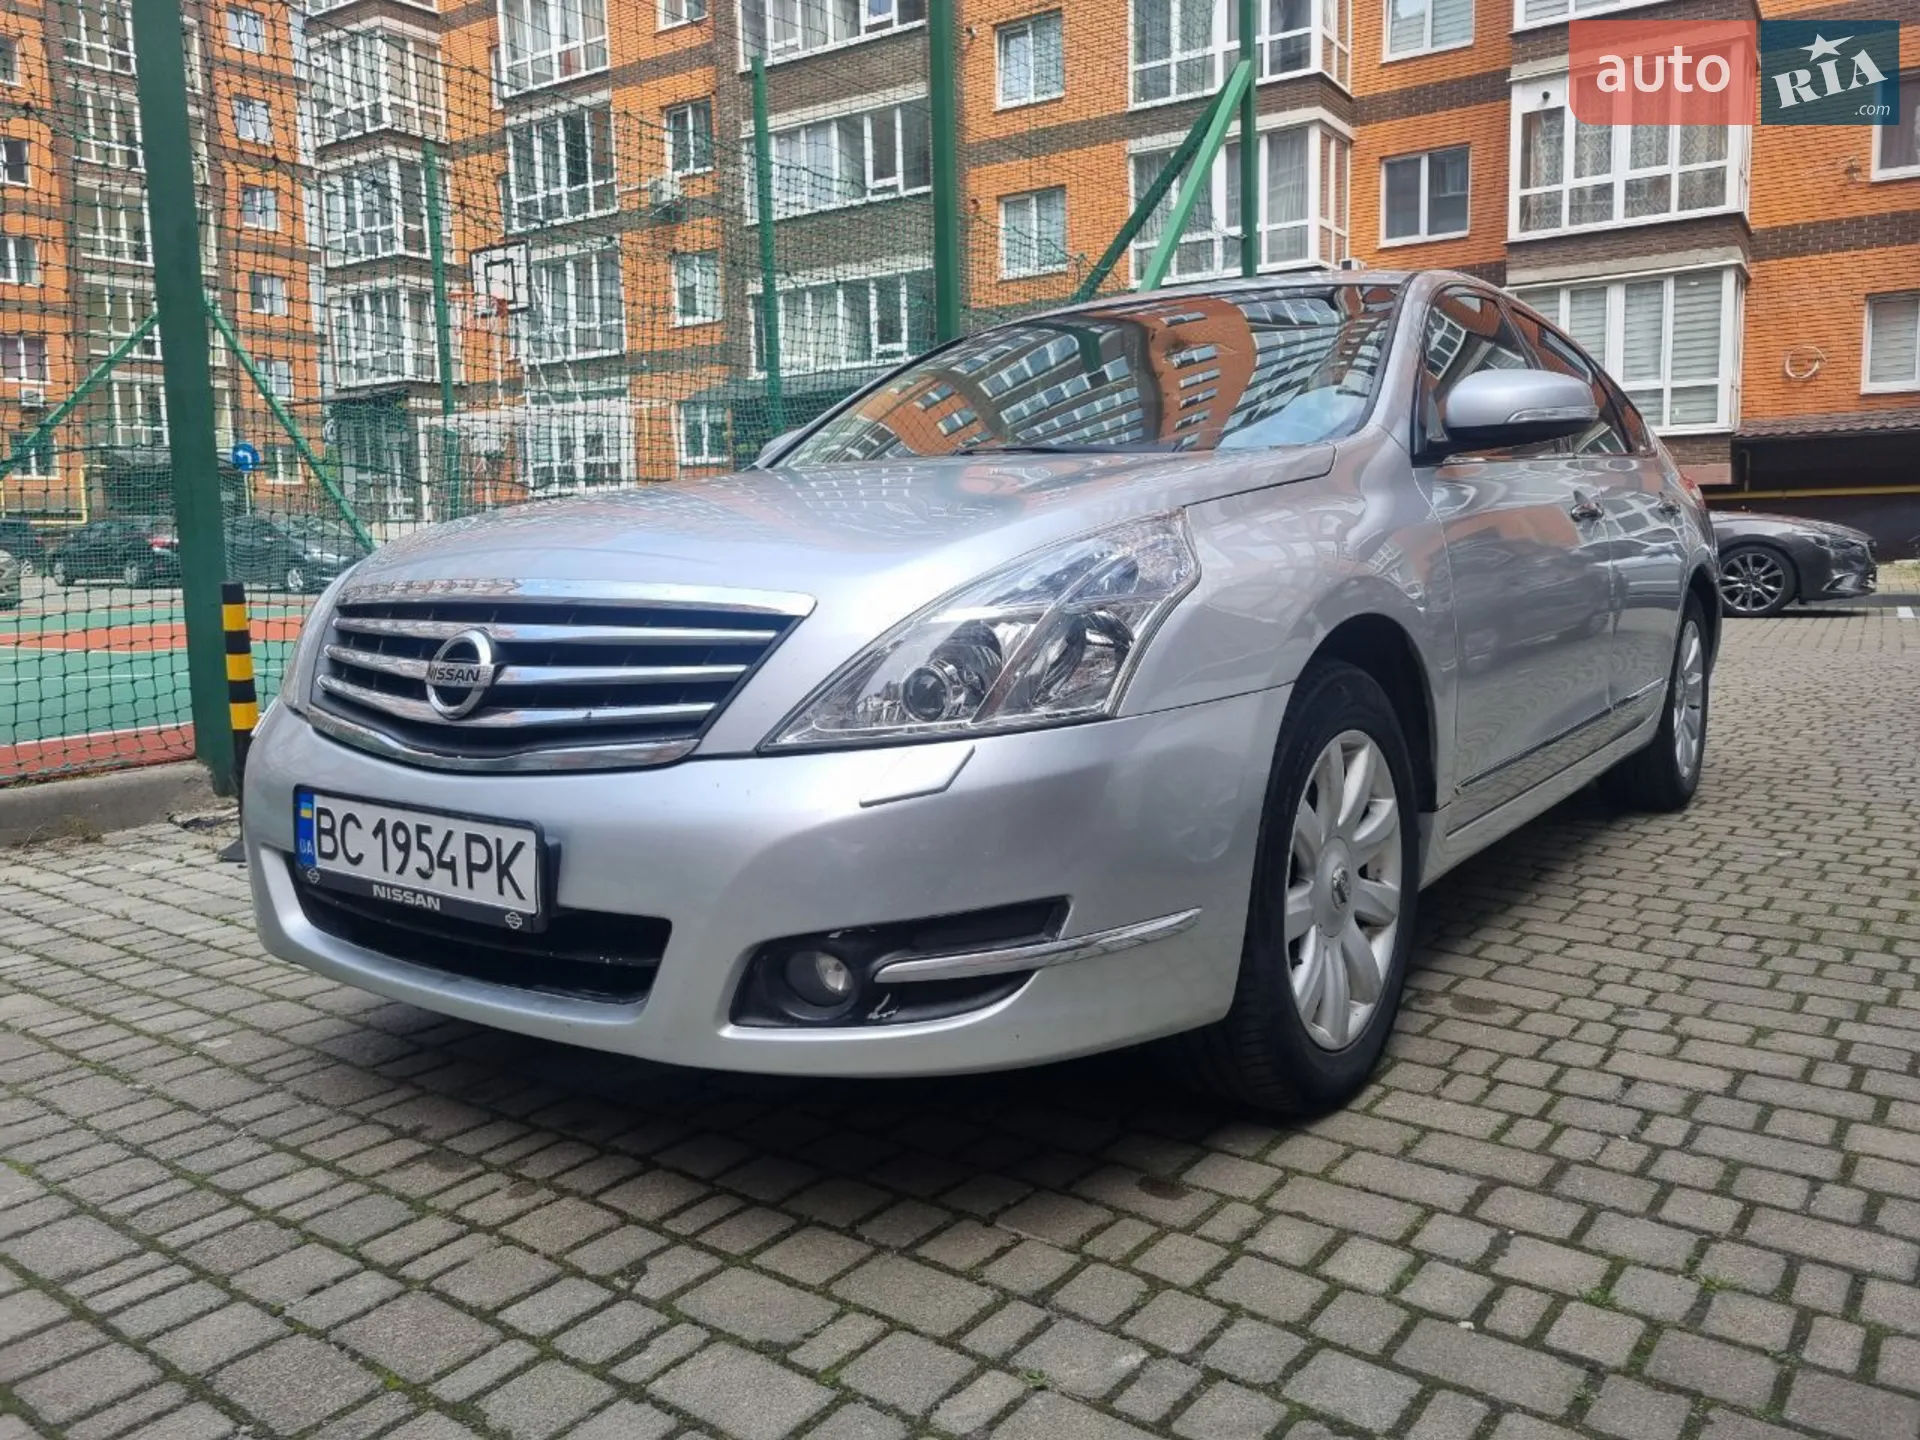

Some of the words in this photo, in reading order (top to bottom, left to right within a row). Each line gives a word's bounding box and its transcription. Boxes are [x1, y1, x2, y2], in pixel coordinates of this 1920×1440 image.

[427, 665, 480, 682] NISSAN
[300, 838, 314, 856] UA
[372, 884, 441, 911] NISSAN
